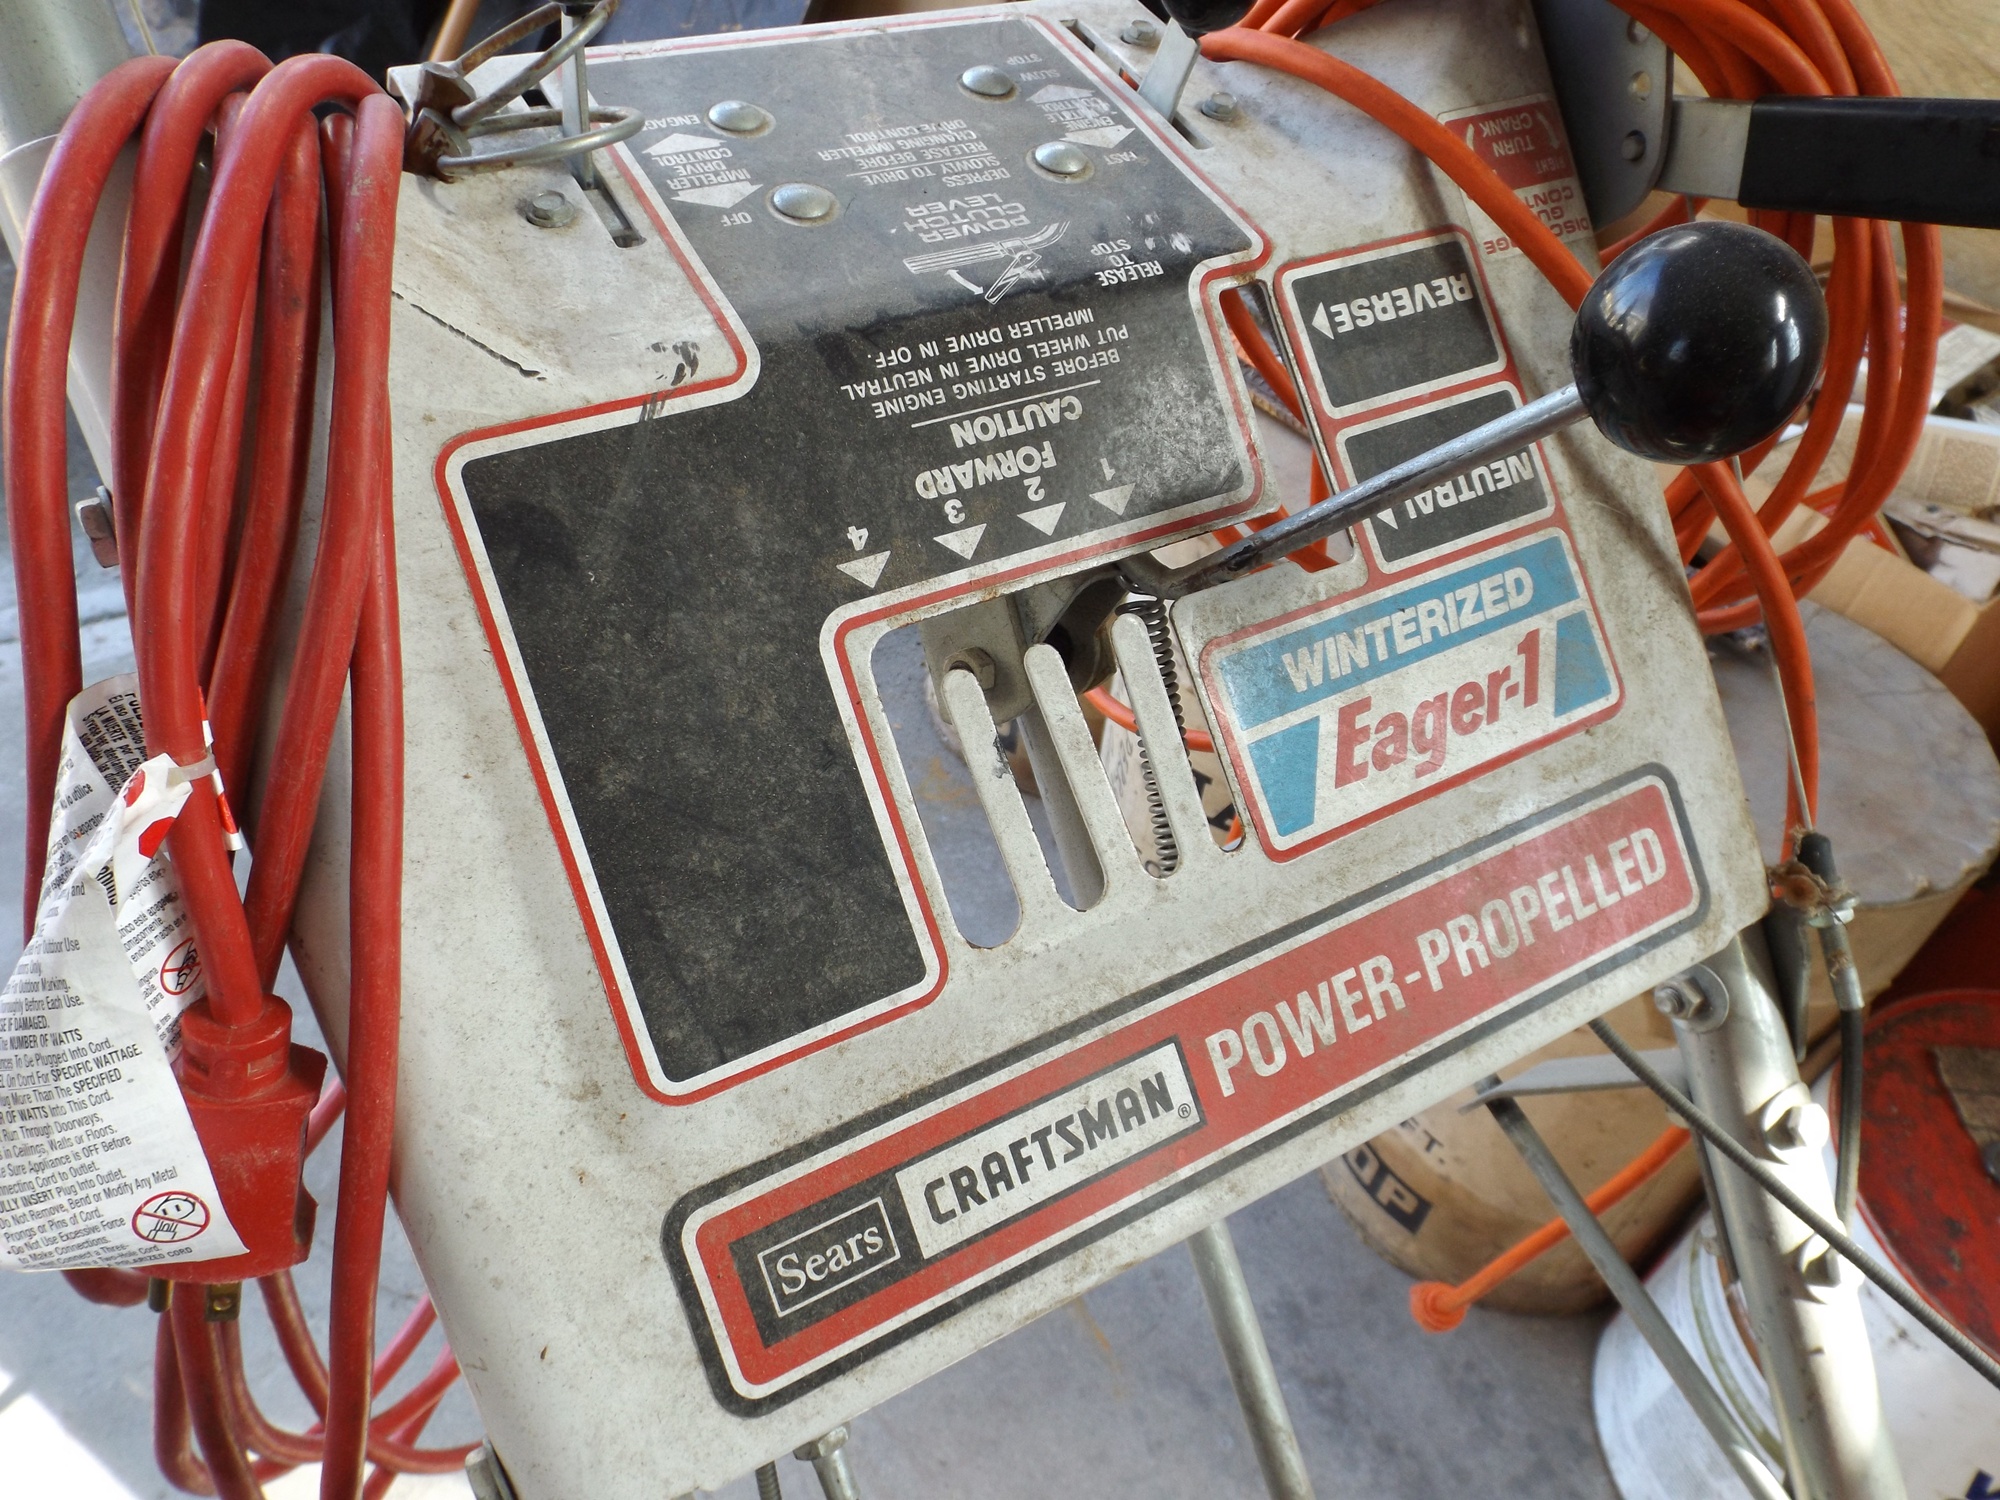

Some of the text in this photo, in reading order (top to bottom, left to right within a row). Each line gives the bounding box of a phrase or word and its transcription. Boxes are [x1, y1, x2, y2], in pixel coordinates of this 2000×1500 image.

[1006, 53, 1042, 66] STOP
[1020, 69, 1060, 82] SLOW
[641, 114, 700, 131] ENGAG
[1044, 106, 1117, 123] TTLE
[1062, 116, 1116, 132] ENGINE
[1479, 112, 1533, 138] CRANK
[845, 119, 967, 143] DRIVE CONTROL
[651, 148, 733, 166] CONTROL
[818, 130, 977, 162] CHANGING IMPELLER
[855, 141, 988, 169] RELEASE BEFORE
[1104, 151, 1138, 165] FAST
[1492, 135, 1535, 157] TURN
[666, 168, 751, 190] IMPELLER
[673, 160, 727, 175] DRIVE
[860, 155, 1000, 186] SLOWLY TO DRIVE
[942, 167, 1011, 187] DEPRESS
[905, 192, 1003, 217] LEVER
[1524, 186, 1574, 208] CONT
[720, 211, 752, 226] OFF
[903, 202, 1026, 232] CLUTCH
[918, 214, 1031, 243] POWER
[1090, 239, 1131, 255] STOP
[1484, 217, 1589, 255] DISCGE
[1094, 260, 1164, 286] RELEASE
[1110, 253, 1134, 267] TO
[1330, 273, 1473, 333] REVERSE
[867, 307, 1094, 369] IMPELLER DRIVE IN OFF.
[840, 324, 1129, 401] PUT WHEEL DRIVE IN NEUTRAL
[871, 349, 1120, 418] BEFORE STARTING ENGINE
[949, 395, 1083, 448] CAUTION
[915, 441, 1057, 499] FORWARD
[1100, 457, 1116, 481] 1
[1023, 476, 1045, 501] 2
[944, 499, 966, 524] 3
[847, 526, 869, 551] 4
[1282, 567, 1534, 693] WINTERIZED
[1335, 627, 1540, 789] Eager-1
[103, 715, 128, 743] MUERTE
[117, 744, 132, 757] por
[70, 782, 93, 801] utilice
[71, 882, 86, 897] and
[64, 937, 81, 951] Use
[1204, 828, 1667, 1098] POWER-PROPELLED
[46, 995, 63, 1010] Each
[63, 994, 84, 1008] Use.
[15, 1015, 50, 1031] DAMAGED.
[10, 1028, 83, 1050] NUMBER OF WATTS
[14, 1055, 22, 1068] To
[35, 1049, 69, 1068] Plugged
[69, 1047, 88, 1061] Into
[88, 1037, 114, 1054] Cord.
[7, 1073, 16, 1088] On
[18, 1071, 36, 1087] Cord
[36, 1070, 50, 1085] For
[51, 1060, 93, 1082] SPECIFIC
[93, 1044, 143, 1069] WATTAGE.
[11, 1092, 33, 1105] More
[32, 1088, 55, 1102] Than
[54, 1086, 73, 1098] The
[73, 1067, 123, 1094] SPECIFIED
[6, 1110, 17, 1124] OF
[17, 1106, 49, 1121] WATTS
[49, 1104, 68, 1117] Into
[67, 1098, 88, 1114] This
[88, 1089, 114, 1107] Cord.
[2, 1112, 104, 1142] Run Through Doorways,
[3, 1146, 12, 1159] in
[13, 1142, 49, 1158] Ceilings,
[47, 1136, 74, 1152] Walls
[75, 1134, 85, 1145] or
[85, 1124, 118, 1141] Floors.
[7, 1163, 27, 1177] Sure
[28, 1154, 72, 1174] Appliance
[72, 1150, 82, 1161] is
[81, 1143, 100, 1158] OFF
[101, 1135, 132, 1152] Before
[0, 1160, 100, 1197] nnecting Cord to Outlet.
[20, 1168, 127, 1206] INSERT Plug Into Outlet.
[0, 1165, 178, 1230] Do Not Remove, Bend or Modify Any Metal
[3, 1208, 104, 1244] Prongs or Pins of Cord.
[26, 1239, 42, 1252] Not
[42, 1234, 59, 1248] Use
[59, 1223, 101, 1241] Excessive
[101, 1216, 127, 1229] Force
[18, 1255, 30, 1265] to
[29, 1247, 54, 1262] Make
[55, 1235, 112, 1255] Connections.
[99, 1249, 138, 1263] Two-Hole
[138, 1243, 163, 1256] Cord.
[100, 1243, 130, 1255] Three-
[167, 1246, 193, 1258] CORD
[776, 1224, 883, 1295] Sears
